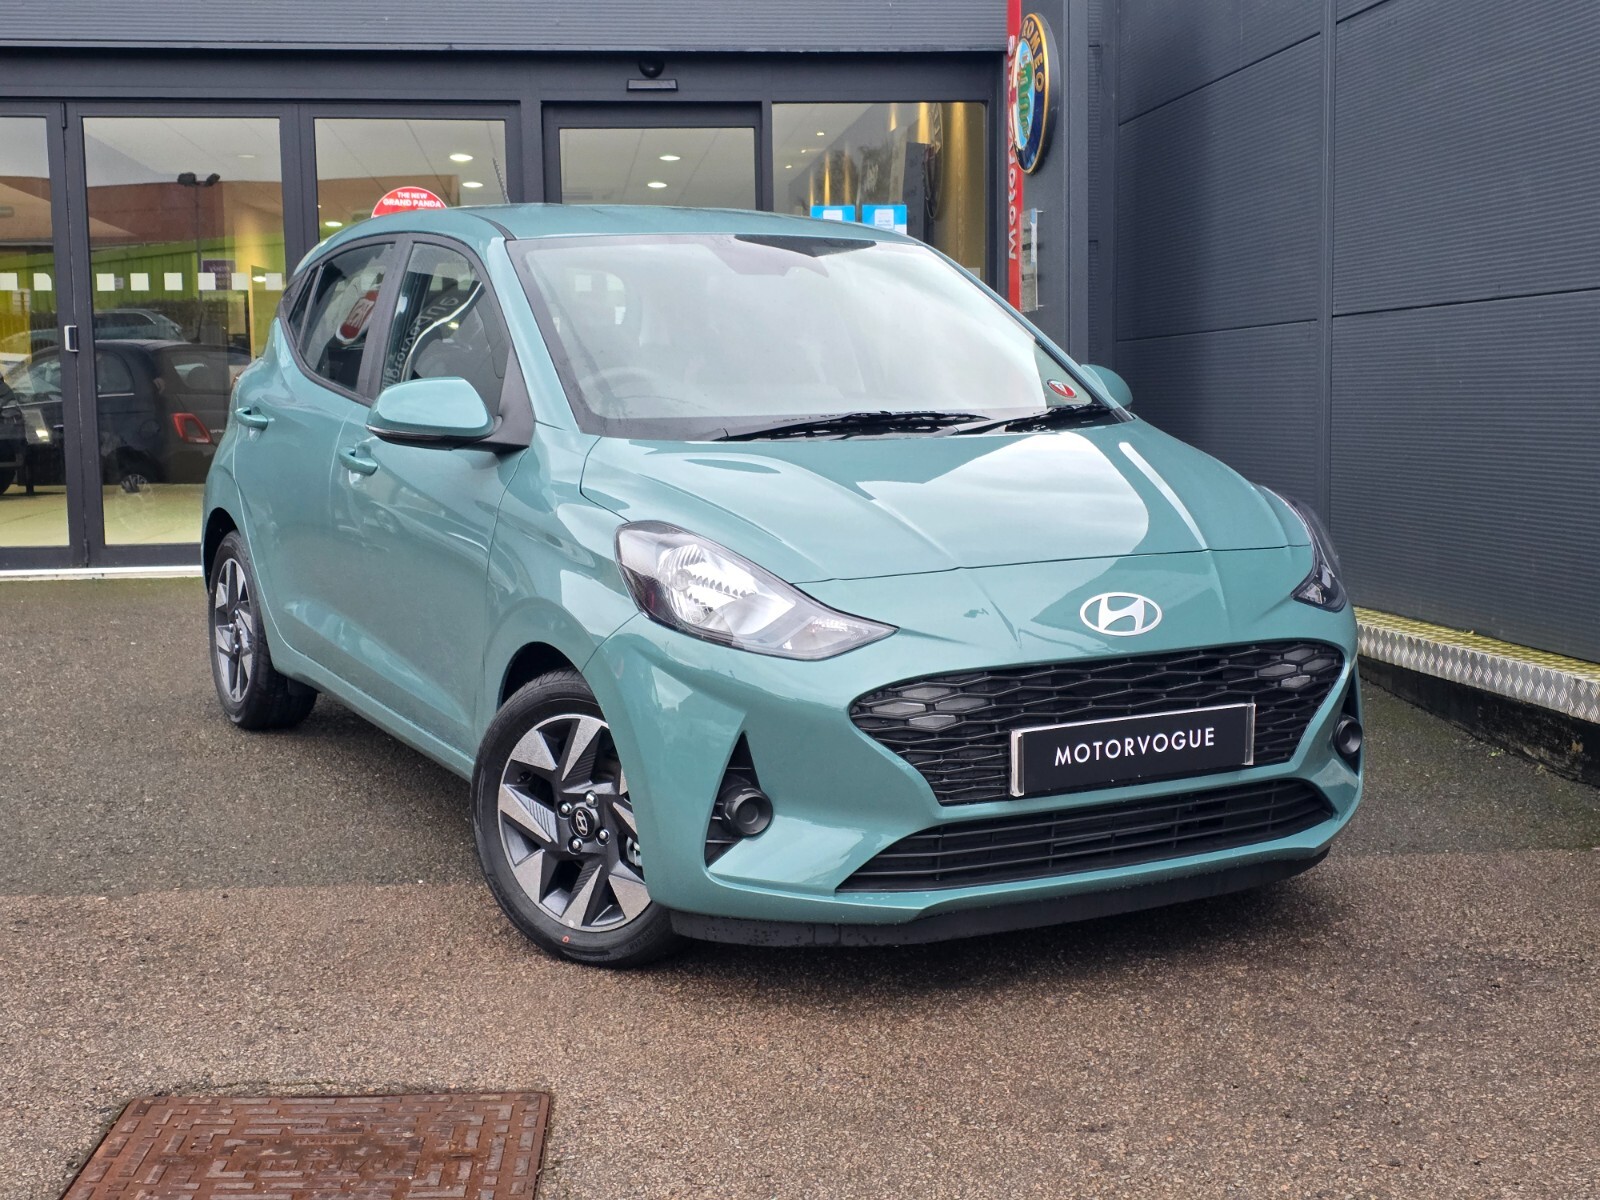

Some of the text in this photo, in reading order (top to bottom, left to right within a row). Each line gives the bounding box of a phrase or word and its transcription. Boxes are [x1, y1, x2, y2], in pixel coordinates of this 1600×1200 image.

[1021, 19, 1045, 93] ROMEO
[1008, 35, 1017, 260] Motorve
[382, 198, 442, 208] GRAND PANDA
[397, 191, 410, 199] THE
[1054, 727, 1215, 767] MOTORVOGUE
